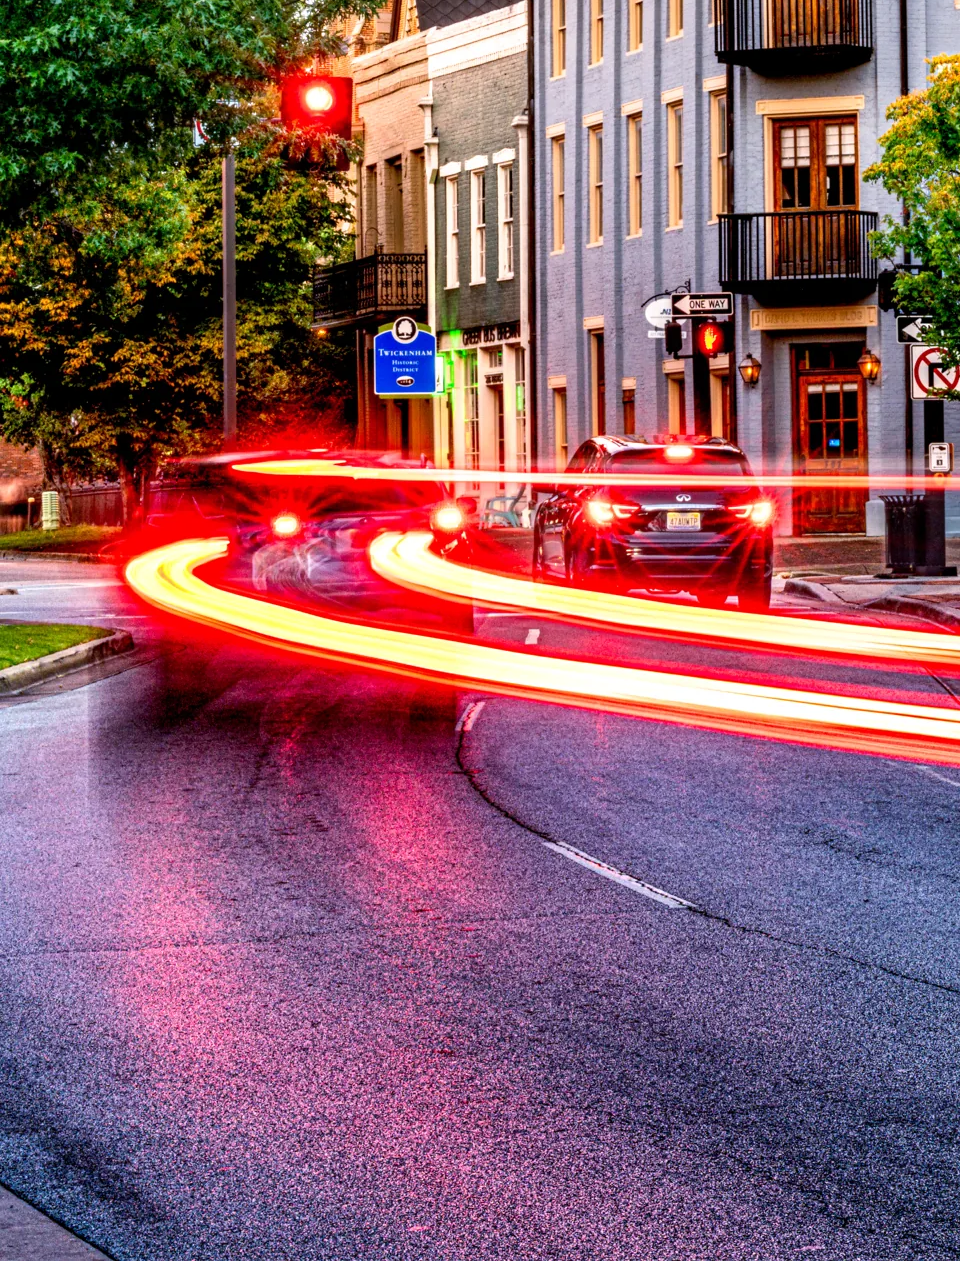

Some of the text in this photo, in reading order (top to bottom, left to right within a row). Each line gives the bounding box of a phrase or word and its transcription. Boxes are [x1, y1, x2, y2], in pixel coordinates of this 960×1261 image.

[689, 299, 726, 309] ONE WAY
[462, 326, 482, 346] GREEN
[483, 325, 496, 343] BUS
[378, 348, 433, 357] TWICKENHAM
